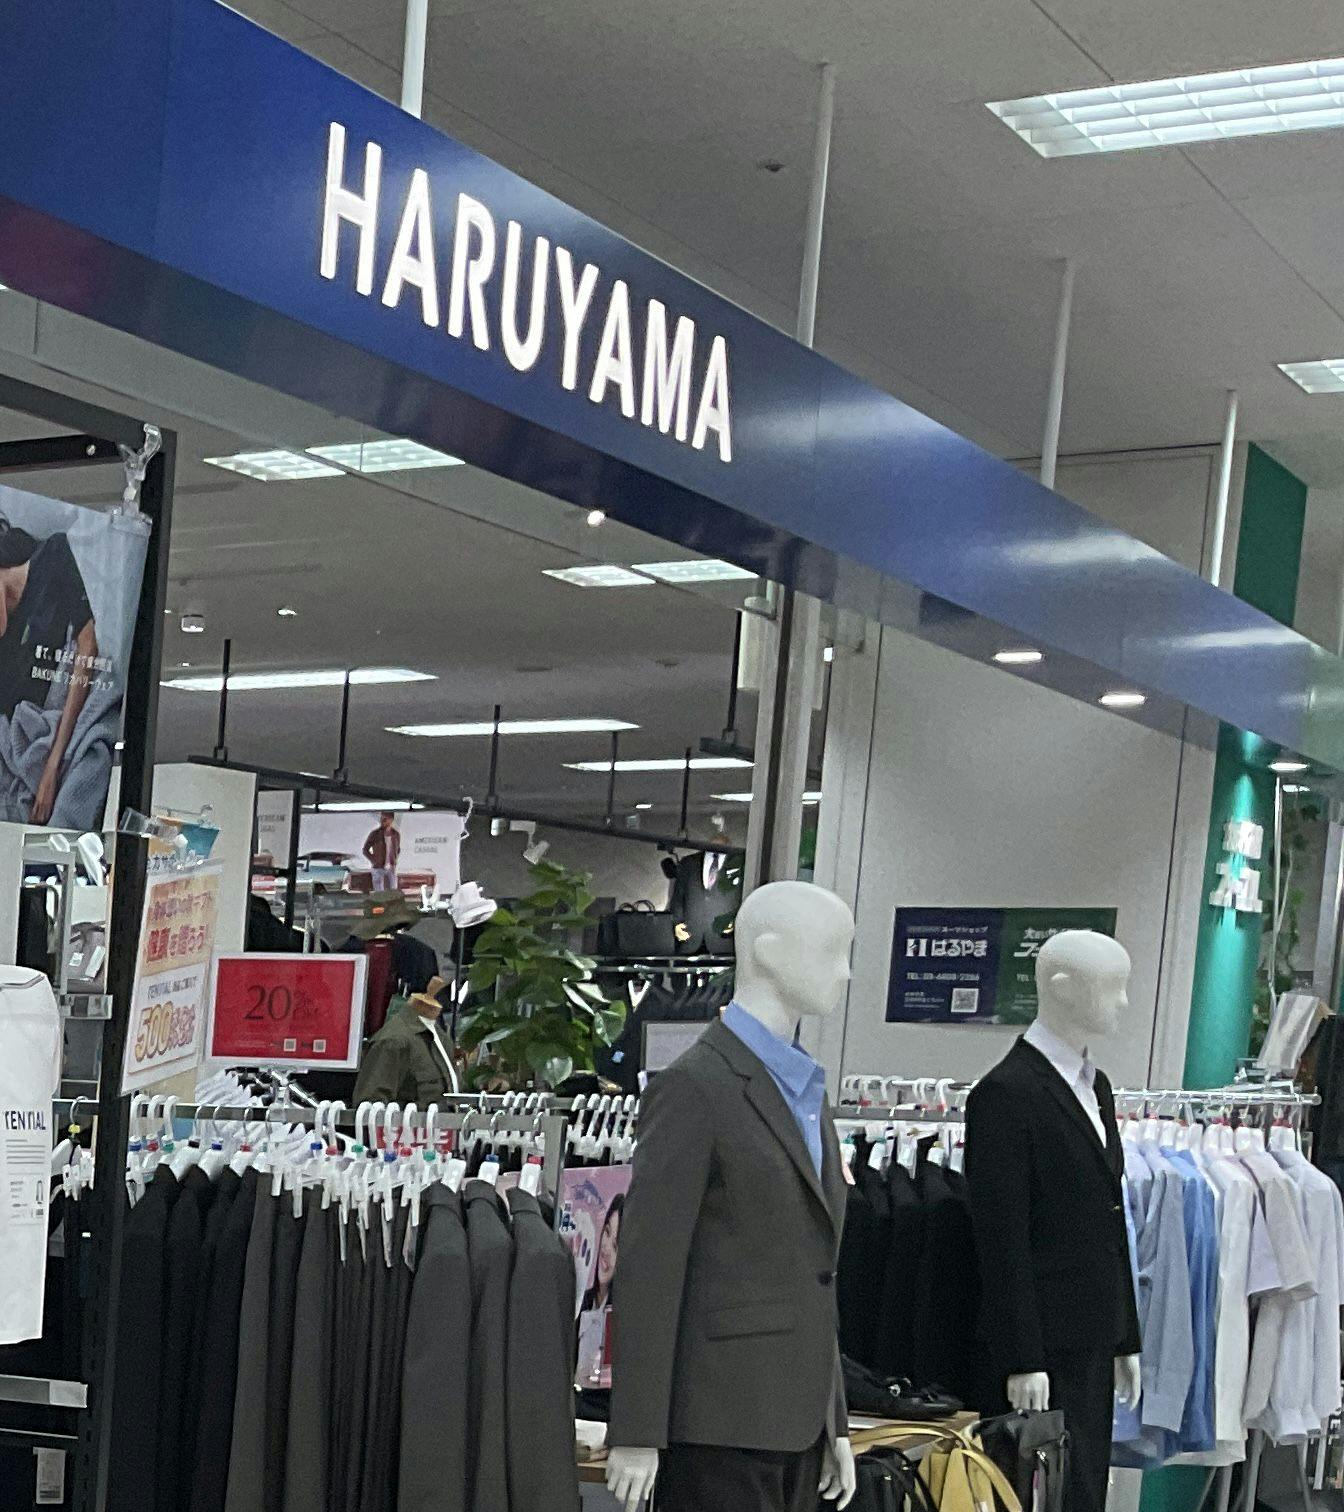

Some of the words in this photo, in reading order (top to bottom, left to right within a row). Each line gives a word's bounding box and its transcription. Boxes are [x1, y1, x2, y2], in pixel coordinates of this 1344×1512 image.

[320, 121, 733, 463] HARUYAMA
[931, 939, 988, 957] はるやま
[4, 1110, 47, 1131] TENTIAL
